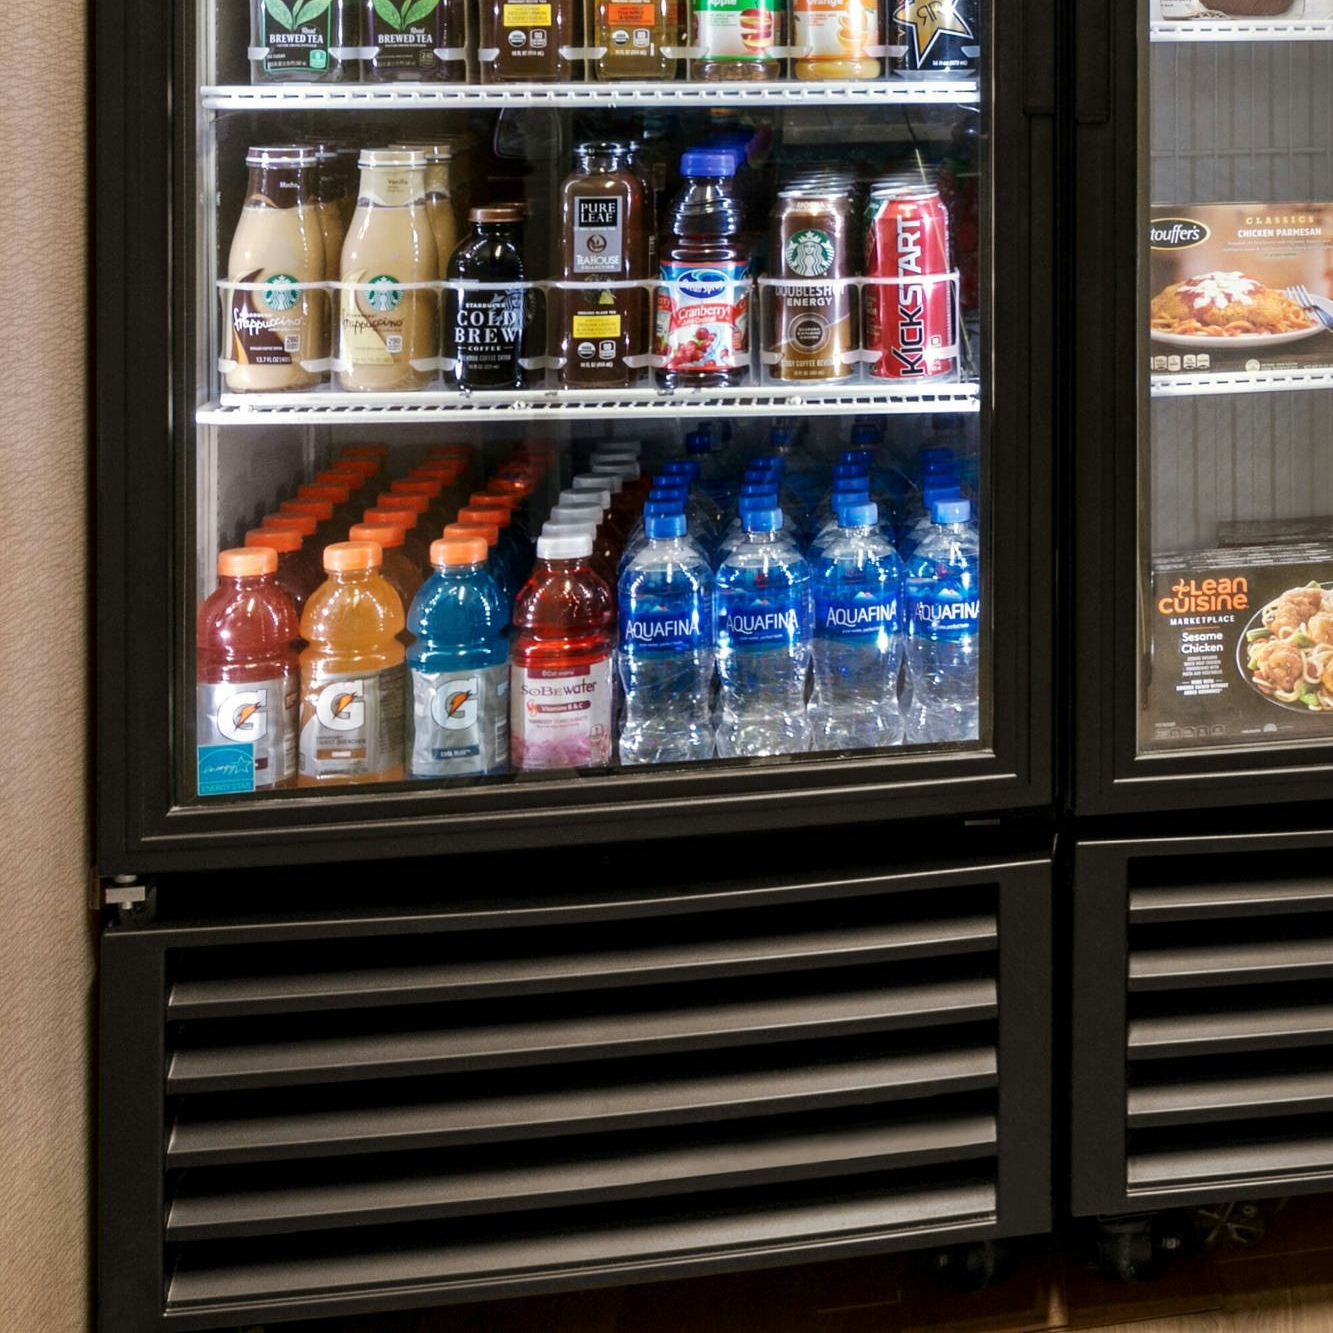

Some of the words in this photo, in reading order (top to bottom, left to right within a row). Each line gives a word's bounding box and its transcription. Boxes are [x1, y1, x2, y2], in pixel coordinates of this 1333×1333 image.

[270, 34, 305, 45] BREWED
[307, 34, 324, 45] TEA
[378, 34, 414, 45] BREWED
[416, 34, 433, 45] TEA
[580, 203, 615, 214] PURE
[580, 212, 613, 224] LEAF
[1246, 215, 1315, 225] CLASSICS
[1237, 228, 1275, 238] CHICKEN
[1276, 227, 1322, 238] PARMESAN
[787, 297, 832, 307] ENERGY
[892, 216, 924, 377] KICKSTART
[457, 309, 517, 327] COLD
[678, 305, 731, 320] Cranberry
[454, 327, 518, 344] BREW
[726, 609, 799, 634] AQUAFINA
[826, 601, 898, 628] AQUAFINA
[1169, 614, 1236, 626] MARKETPLACE
[626, 618, 700, 642] AQUAFINA
[1182, 631, 1224, 643] Sesame
[1181, 642, 1224, 654] Chicken
[564, 678, 598, 695] water
[317, 679, 365, 730] G
[431, 678, 479, 730] G
[217, 690, 268, 742] G
